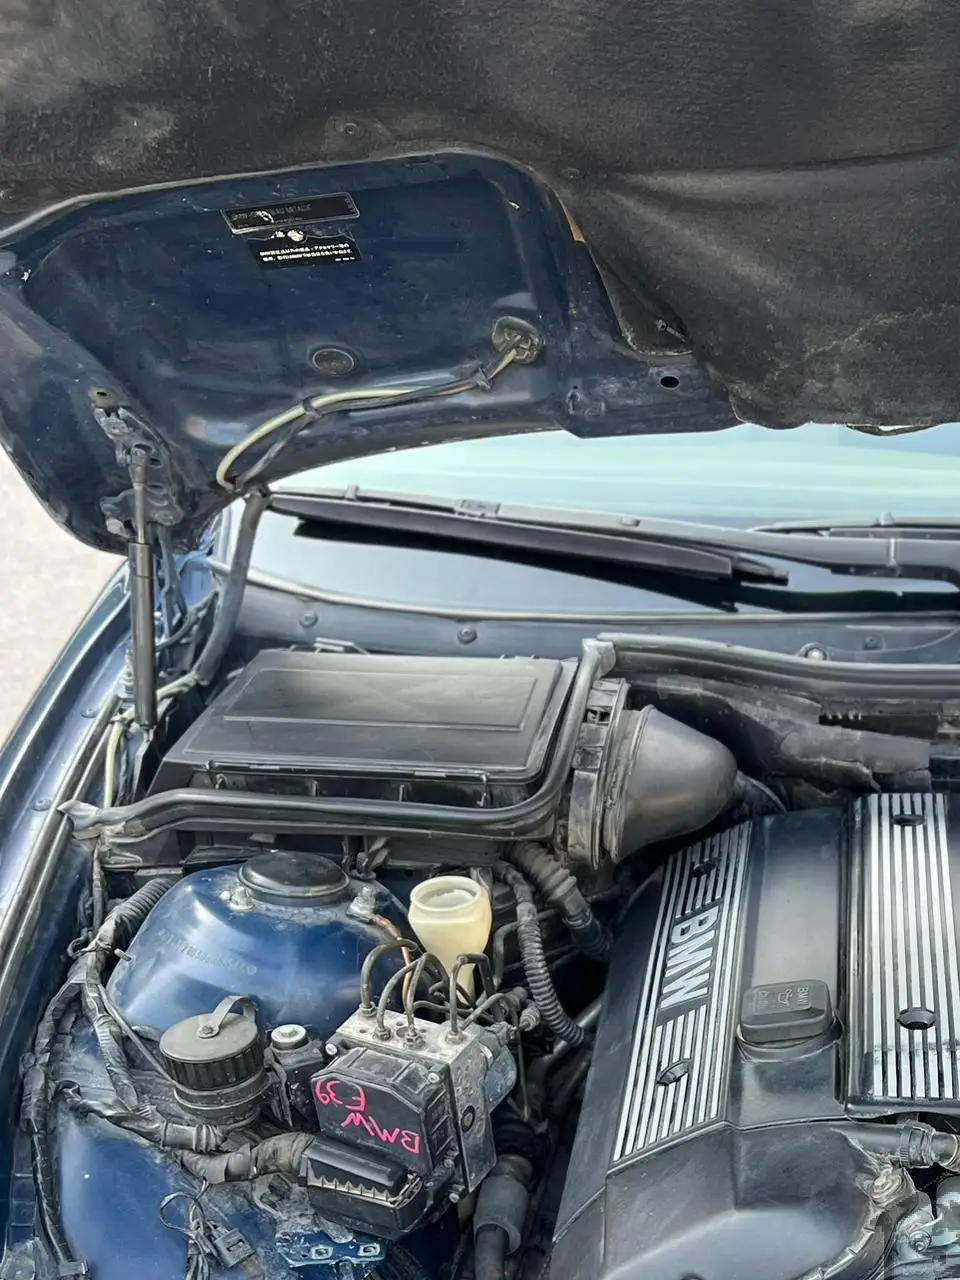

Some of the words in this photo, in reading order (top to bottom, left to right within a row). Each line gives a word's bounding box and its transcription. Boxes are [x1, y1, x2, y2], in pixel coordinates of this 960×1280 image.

[660, 905, 720, 1010] BMW
[797, 986, 809, 1007] BMW
[315, 1080, 366, 1112] E39
[341, 1112, 420, 1154] BMW
